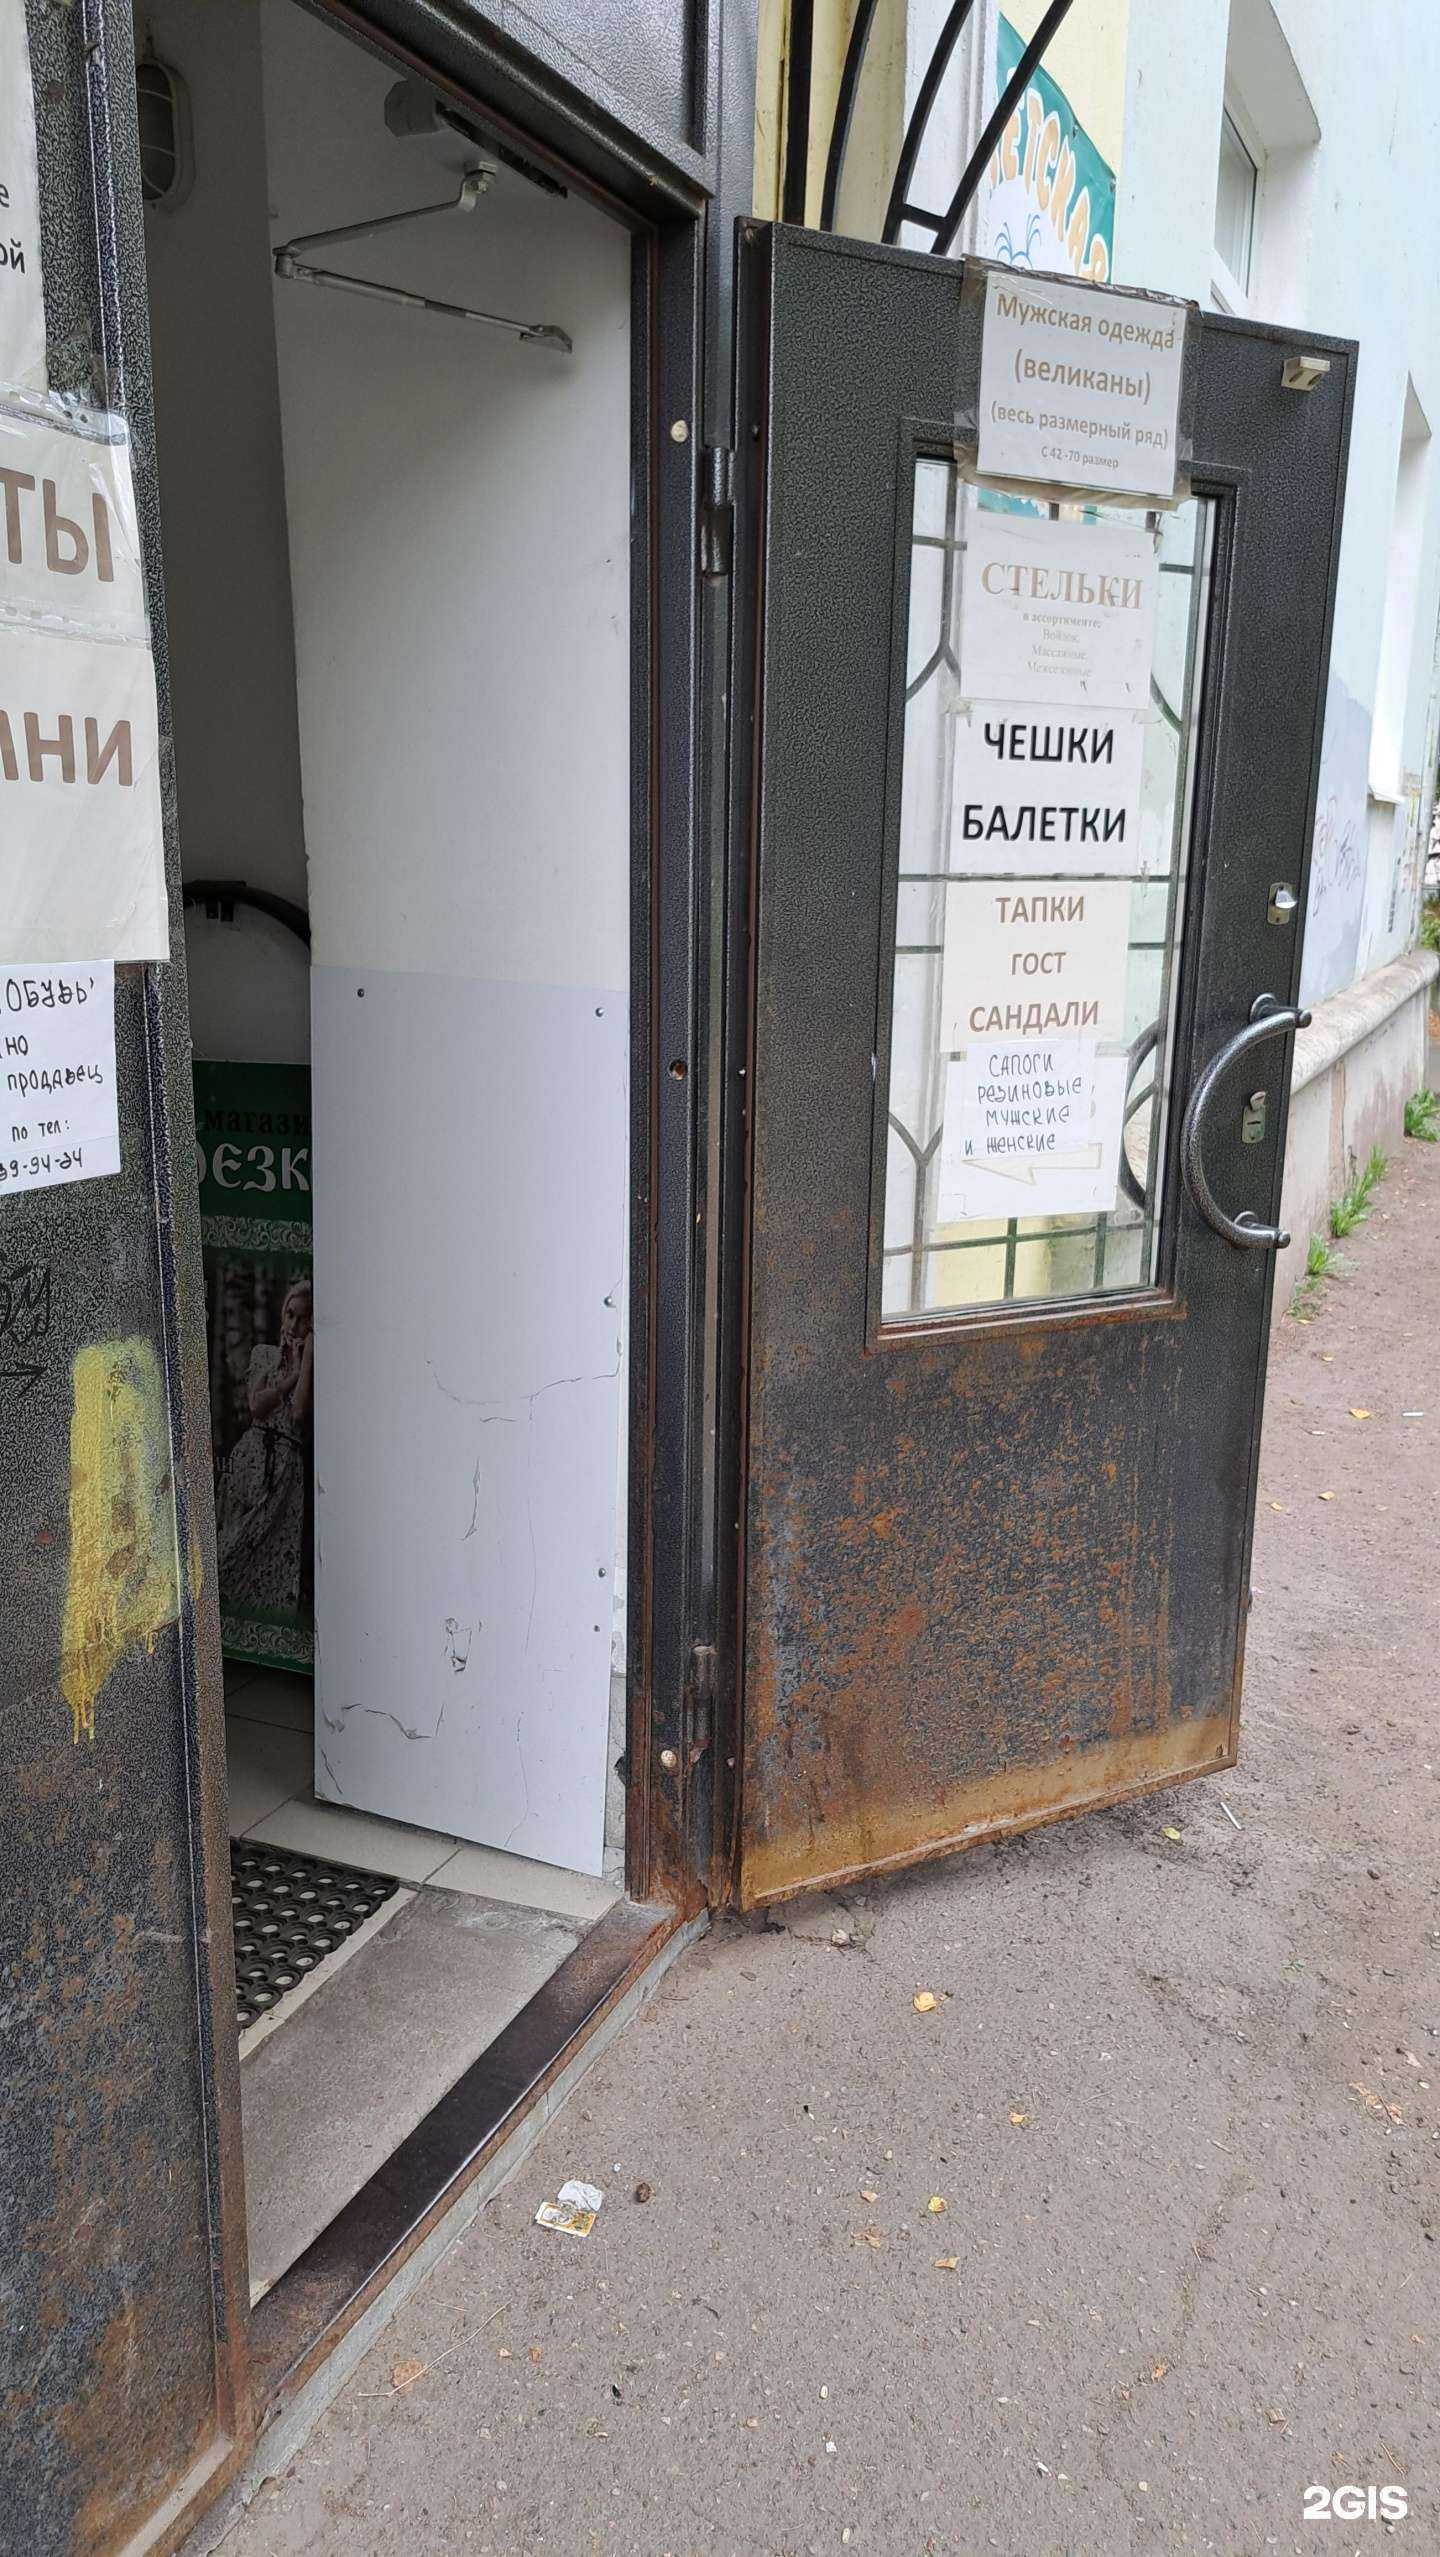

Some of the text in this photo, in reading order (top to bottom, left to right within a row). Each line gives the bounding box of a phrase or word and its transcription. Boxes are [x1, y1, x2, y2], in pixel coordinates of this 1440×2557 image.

[997, 293, 1175, 351] Мужская одежда
[1014, 348, 1152, 405] (великаны)
[991, 400, 1169, 450] (весь размерный ряд)
[1082, 454, 1119, 469] размер
[981, 562, 1144, 609] СТЕЛЬКИ
[984, 722, 1114, 764] ЧЕШКИ
[963, 804, 1126, 842] БАЛЕТКИ
[995, 896, 1085, 923] ТАПКИ
[1011, 952, 1067, 976] ГОСТ
[969, 1000, 1100, 1035] САНДАЛИ
[989, 1053, 1054, 1077] САПОГИ
